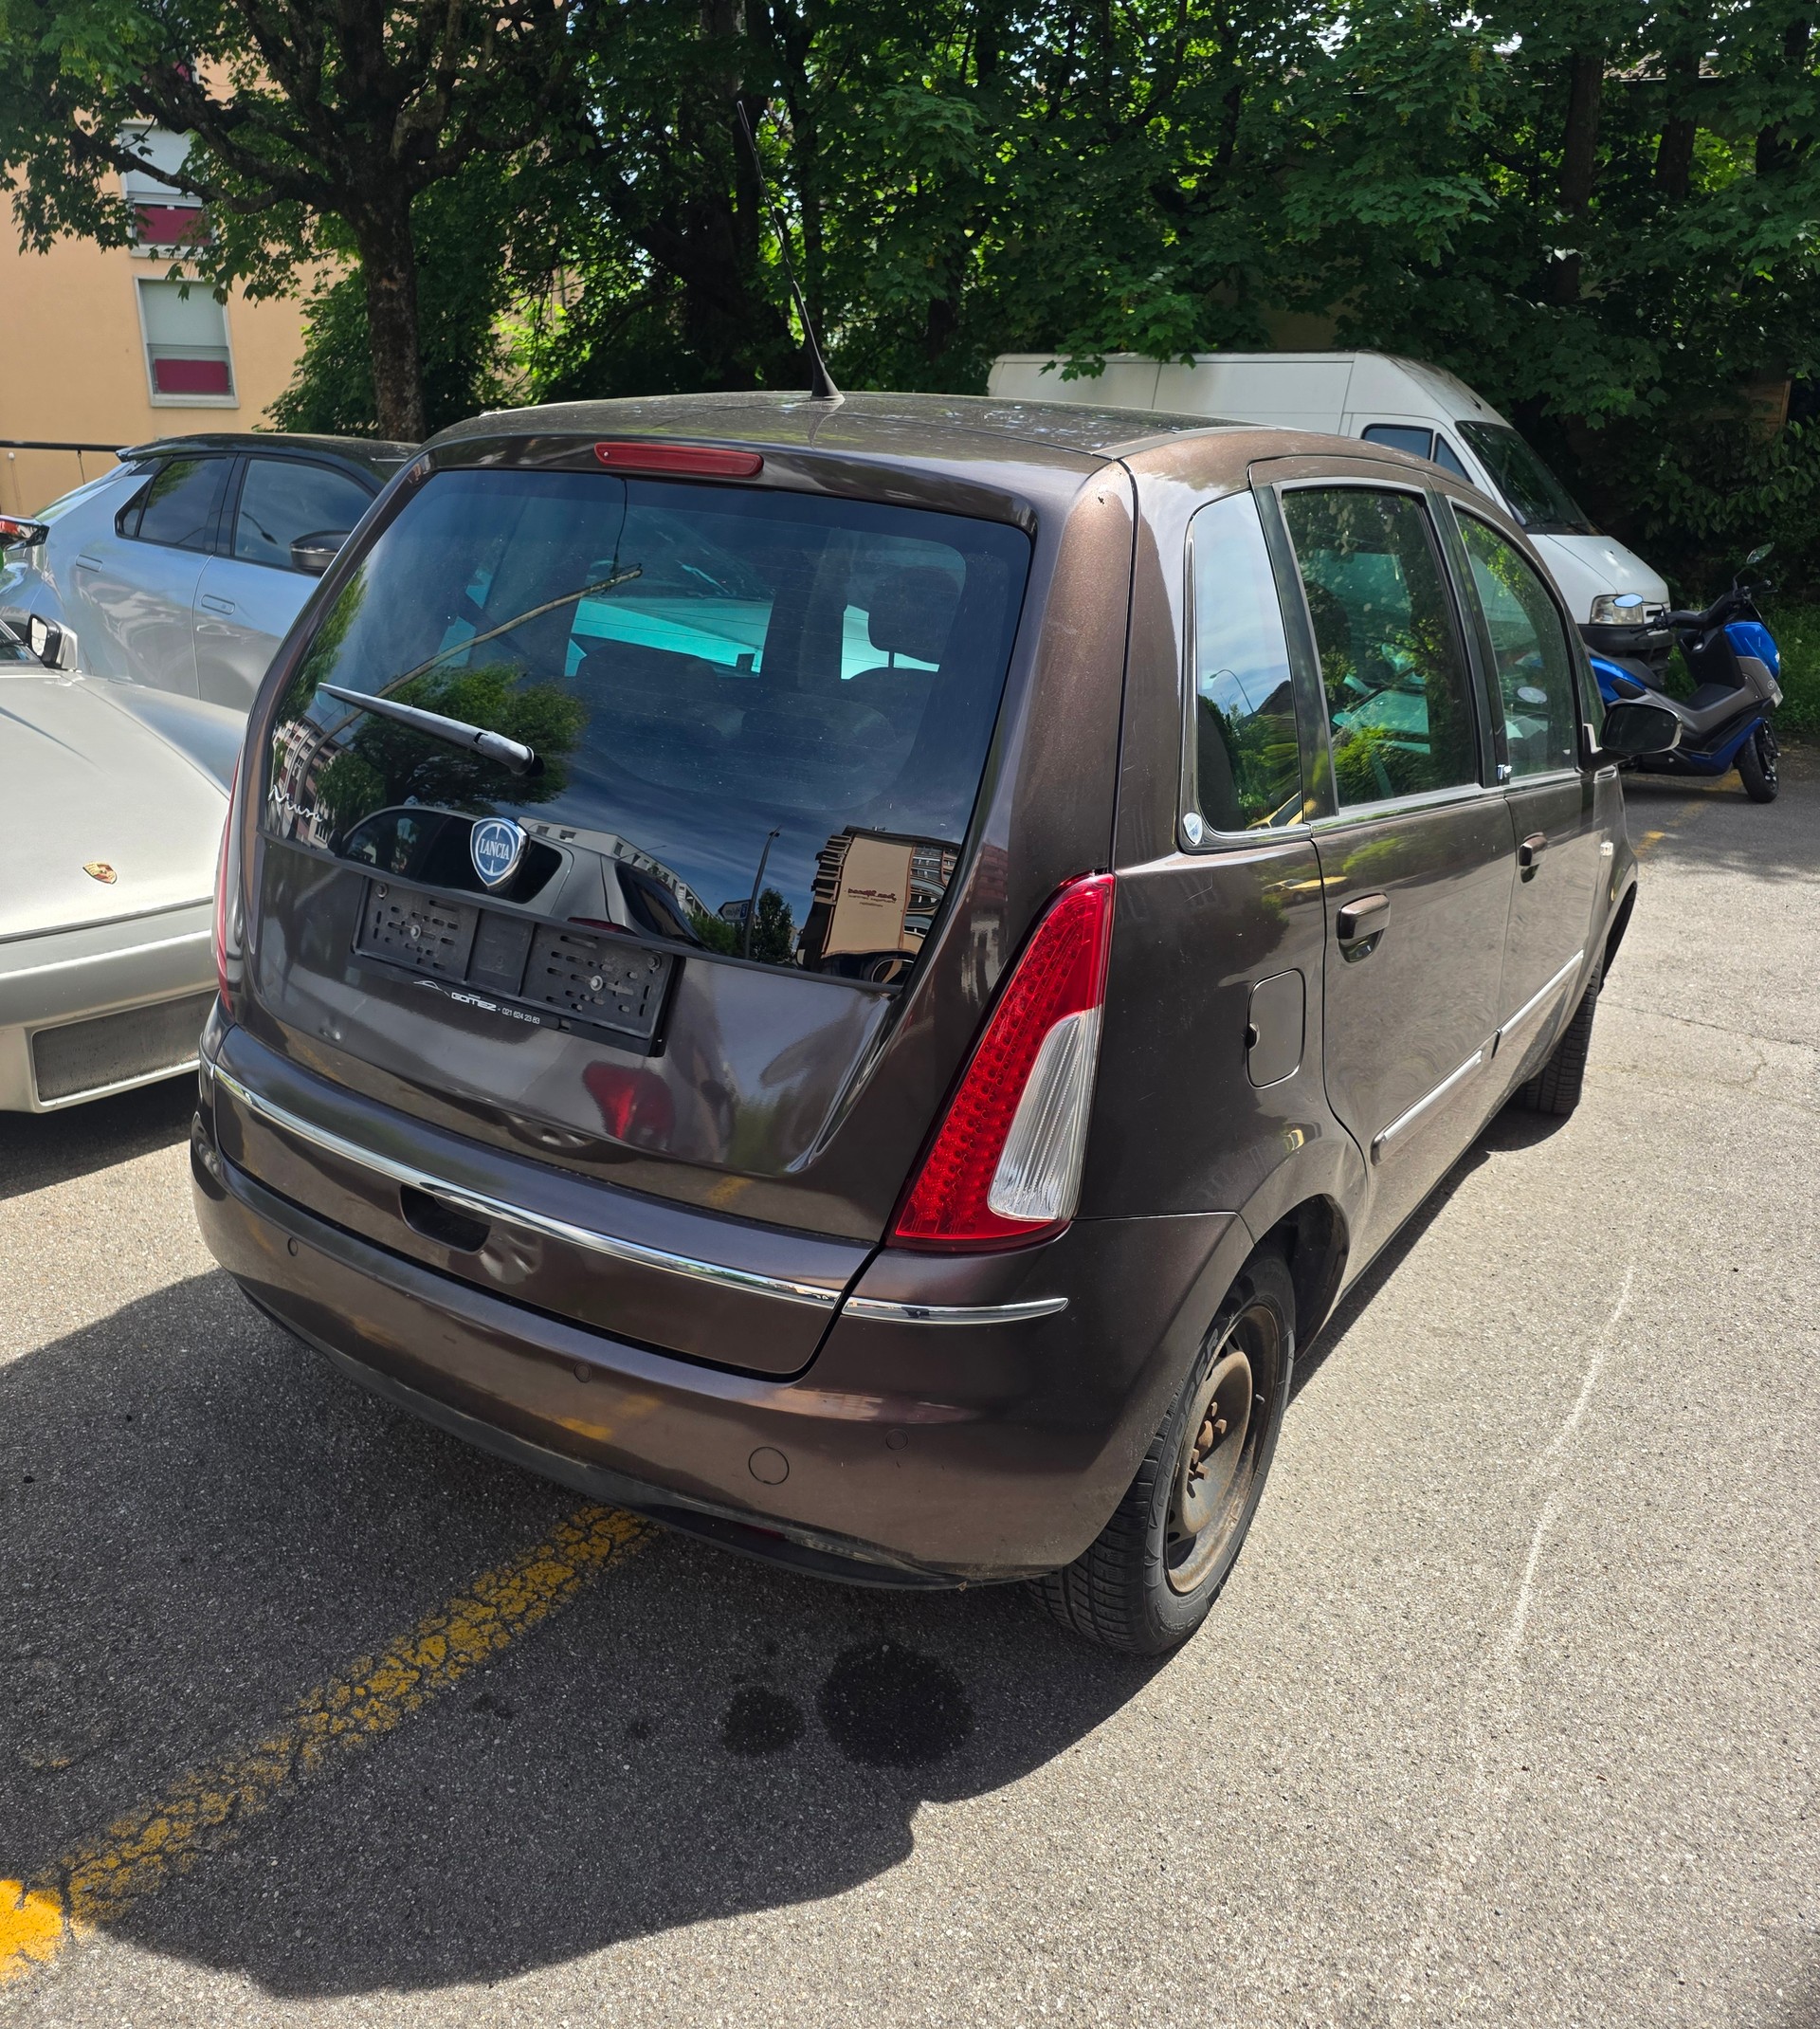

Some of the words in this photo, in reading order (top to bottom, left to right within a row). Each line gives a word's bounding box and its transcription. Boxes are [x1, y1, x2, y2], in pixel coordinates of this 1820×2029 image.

[480, 838, 510, 860] LANCIA
[451, 992, 497, 1012] GOMEZ
[501, 1007, 513, 1016] 021
[513, 1011, 524, 1019] 624
[523, 1014, 532, 1022] 23
